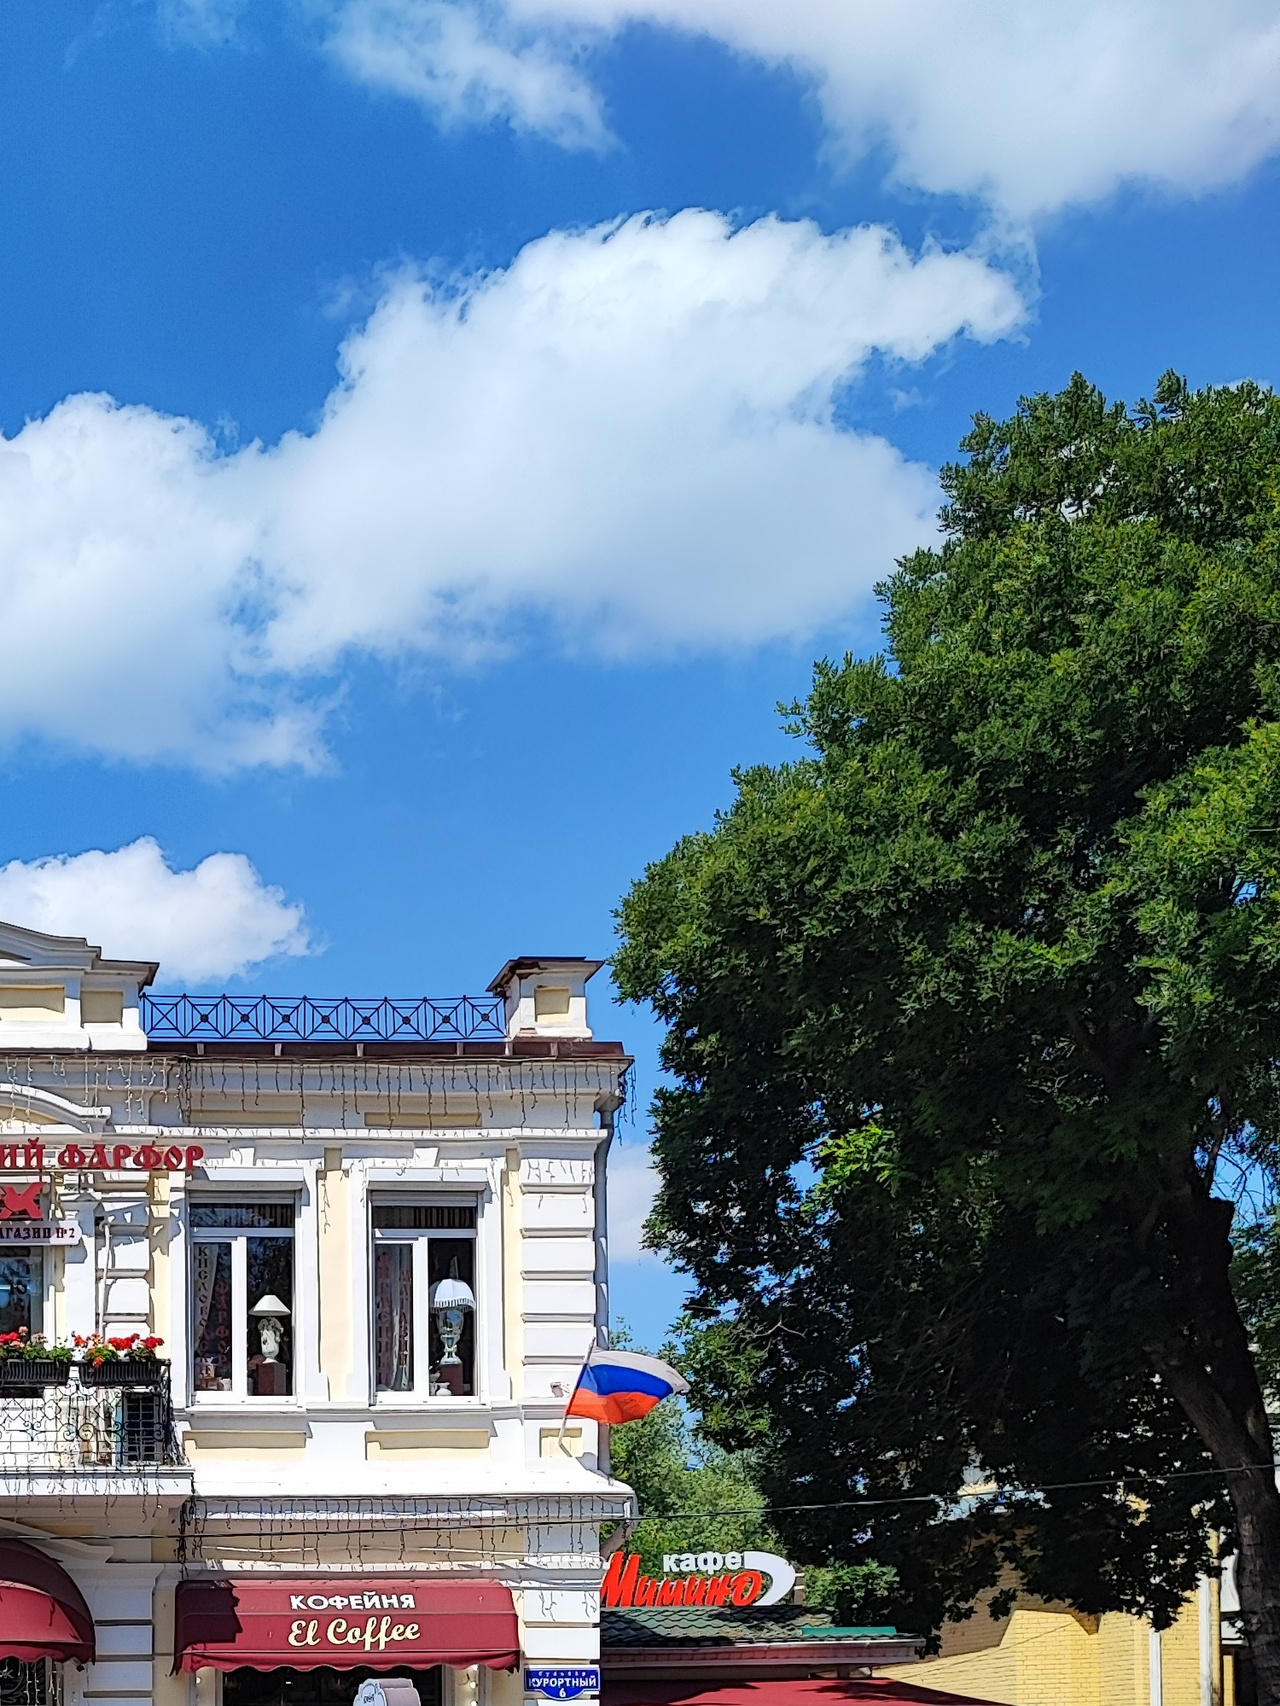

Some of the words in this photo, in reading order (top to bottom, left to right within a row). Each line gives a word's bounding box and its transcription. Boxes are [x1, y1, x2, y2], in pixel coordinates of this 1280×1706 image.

[57, 1143, 205, 1170] ФАРФОР
[663, 1551, 745, 1575] кафе
[600, 1551, 763, 1607] Мимино
[289, 1591, 416, 1610] КОФЕЙНЯ
[287, 1619, 321, 1647] El
[326, 1615, 421, 1651] Coffee
[528, 1675, 597, 1688] КУРОРТНЫЙ
[559, 1687, 567, 1698] 6
